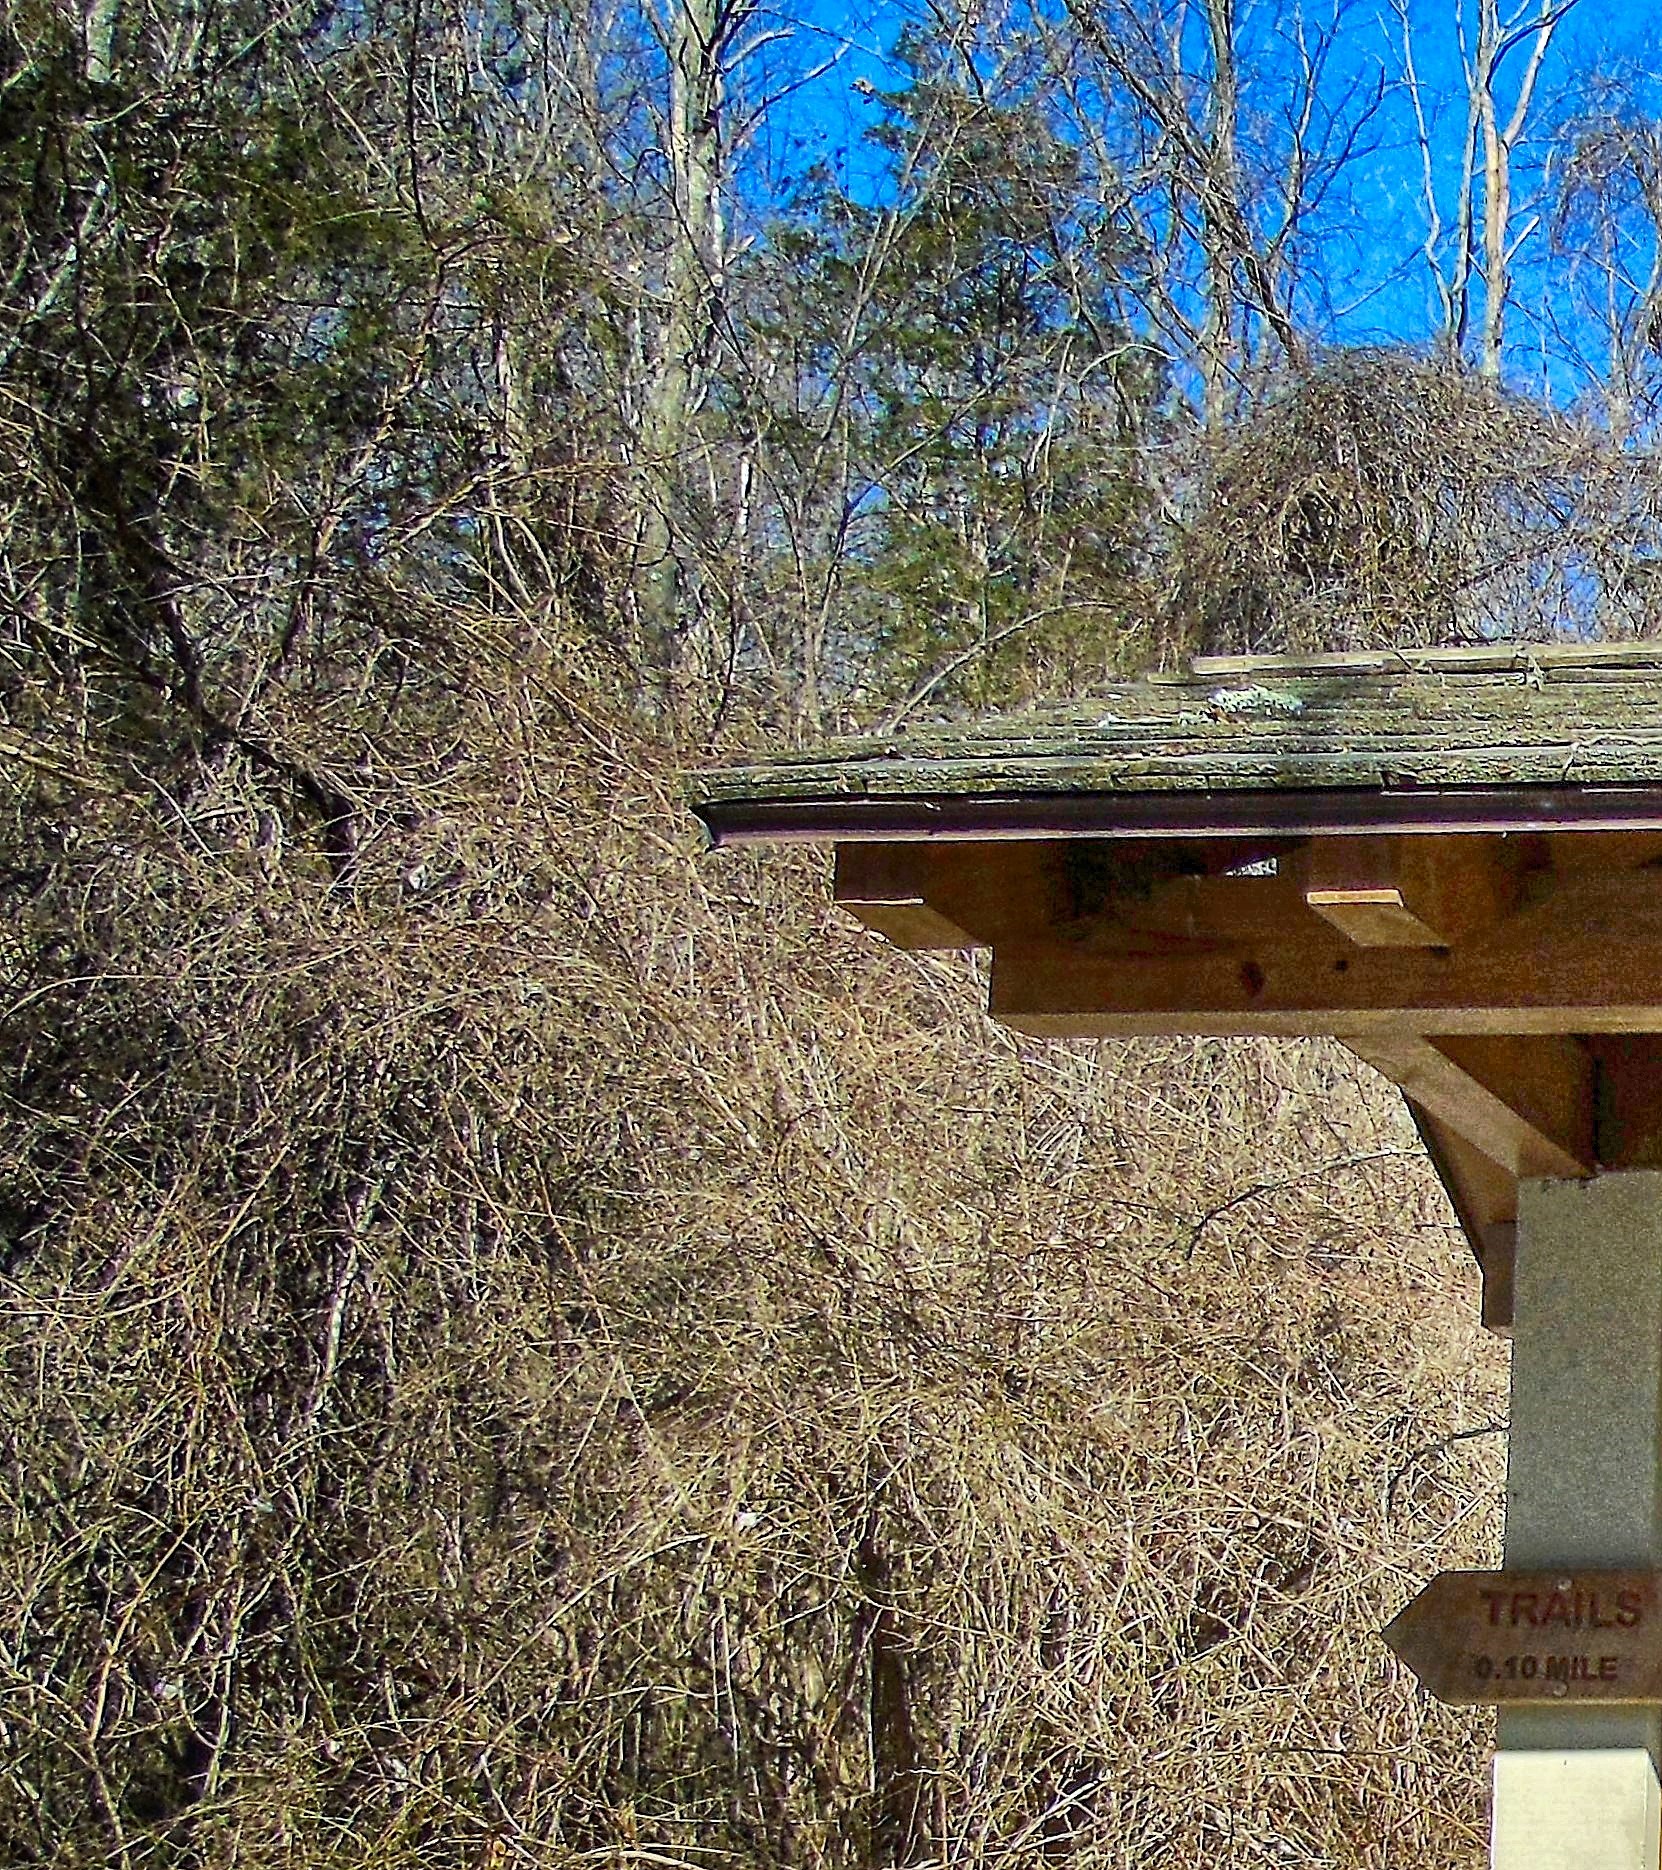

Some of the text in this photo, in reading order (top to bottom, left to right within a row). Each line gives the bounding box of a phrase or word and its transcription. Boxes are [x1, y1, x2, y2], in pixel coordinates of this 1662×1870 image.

[1480, 1590, 1643, 1627] TRAILS
[1476, 1655, 1619, 1681] 0.10 MILE
